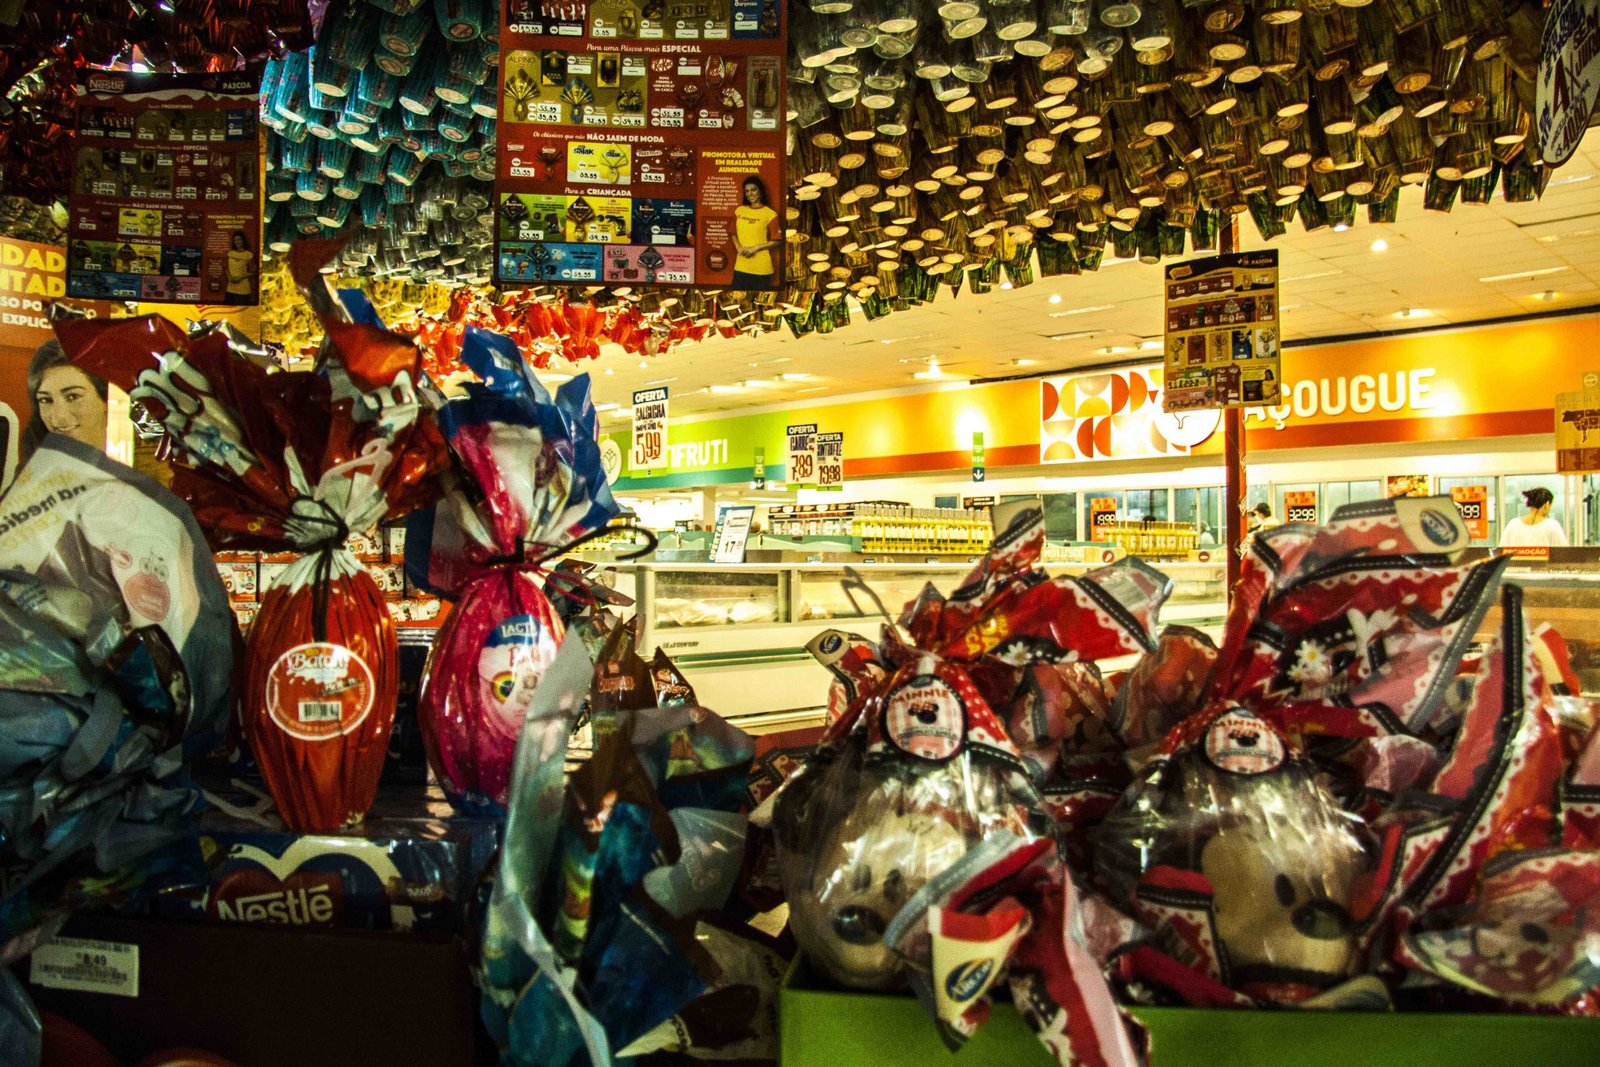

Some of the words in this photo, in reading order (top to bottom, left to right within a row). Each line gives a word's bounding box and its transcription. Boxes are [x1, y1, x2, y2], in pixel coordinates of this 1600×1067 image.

[661, 45, 702, 53] ESPECIAL
[586, 133, 605, 141] NÃO
[586, 188, 632, 197] CRIANÇADA
[0, 268, 66, 298] TAD
[634, 389, 667, 403] OFERTA
[788, 425, 816, 435] OFERTA
[817, 434, 842, 442] OFERTA
[668, 438, 728, 468] IFRUTI
[216, 885, 334, 926] Nestlé
